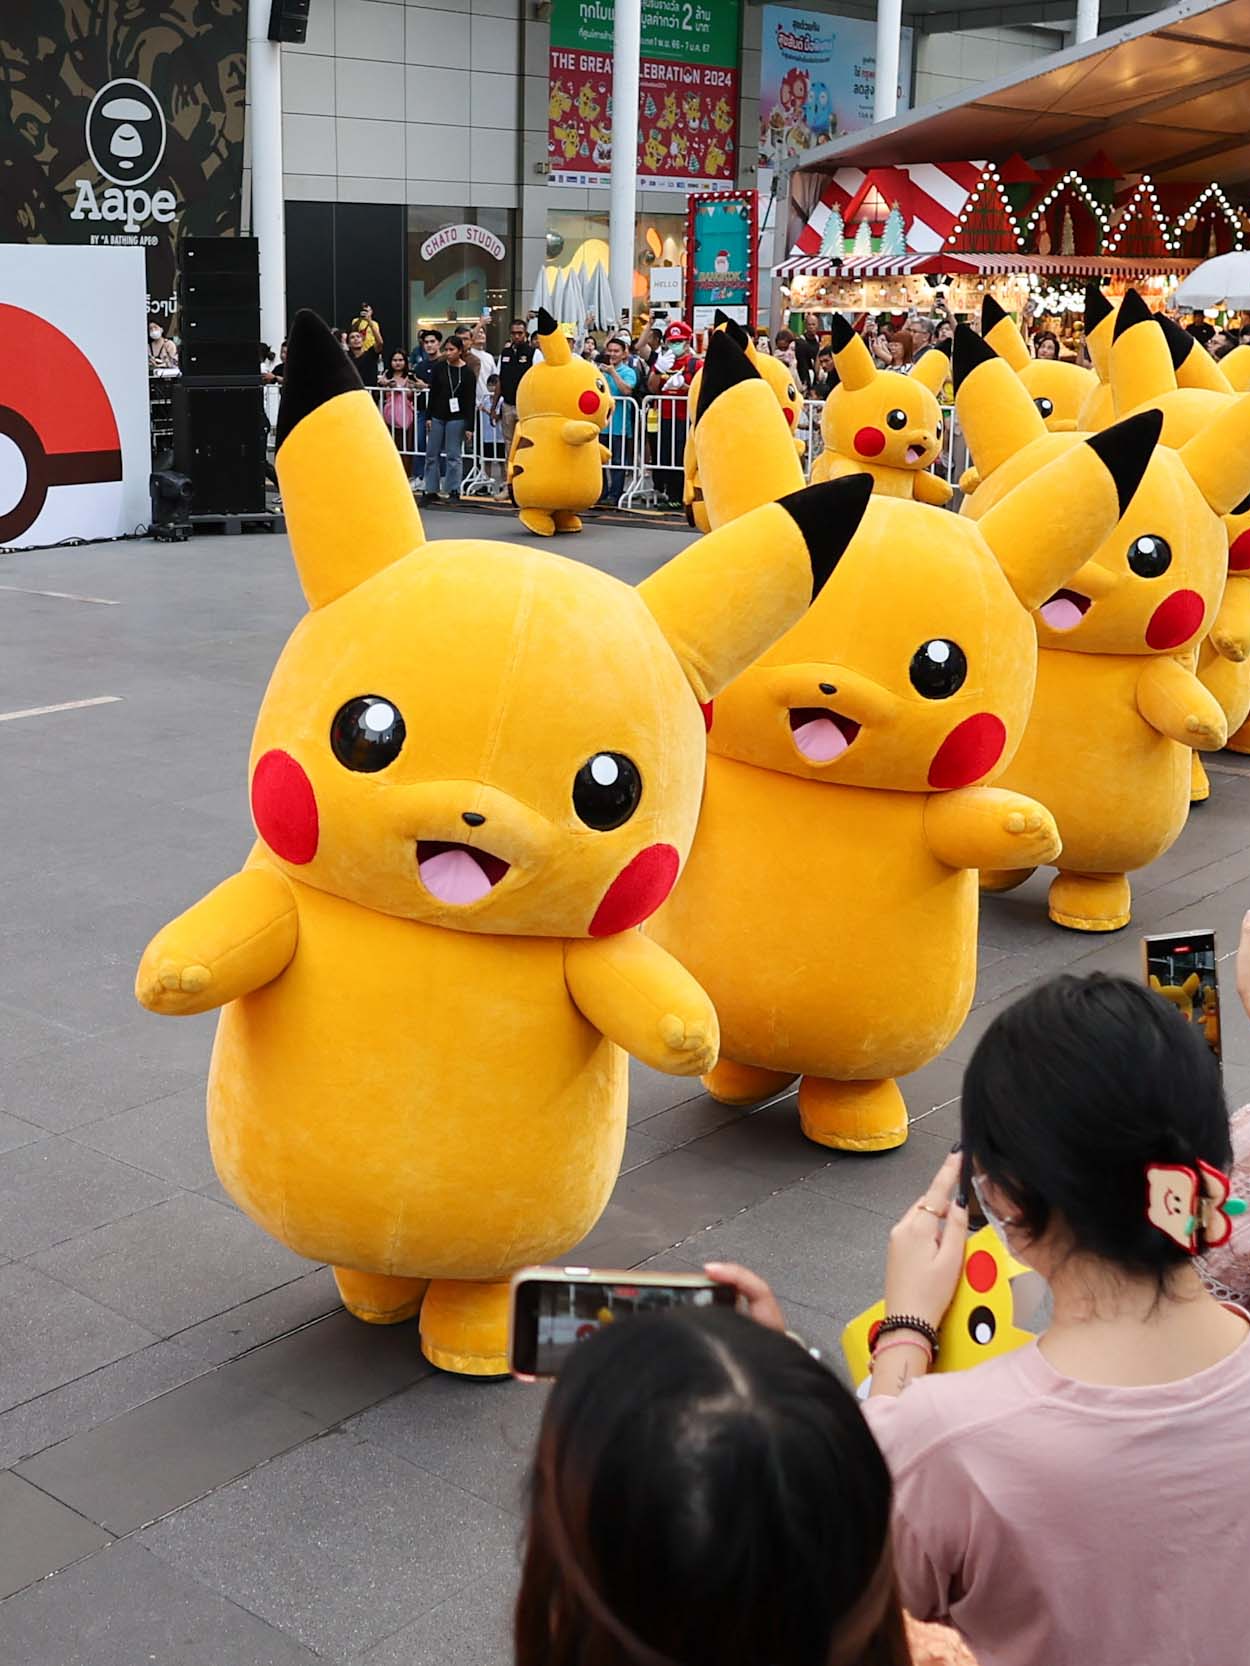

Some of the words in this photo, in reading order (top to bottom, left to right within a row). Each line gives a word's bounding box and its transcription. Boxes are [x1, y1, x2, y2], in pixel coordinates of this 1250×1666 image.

[682, 3, 693, 31] 2
[552, 52, 575, 70] THE
[640, 63, 700, 84] EBRATION
[704, 71, 732, 87] 2024
[70, 179, 176, 233] Aape
[90, 234, 100, 245] BY
[110, 235, 139, 246] BATHING
[425, 228, 457, 256] CHATO
[466, 228, 502, 257] STUDIO
